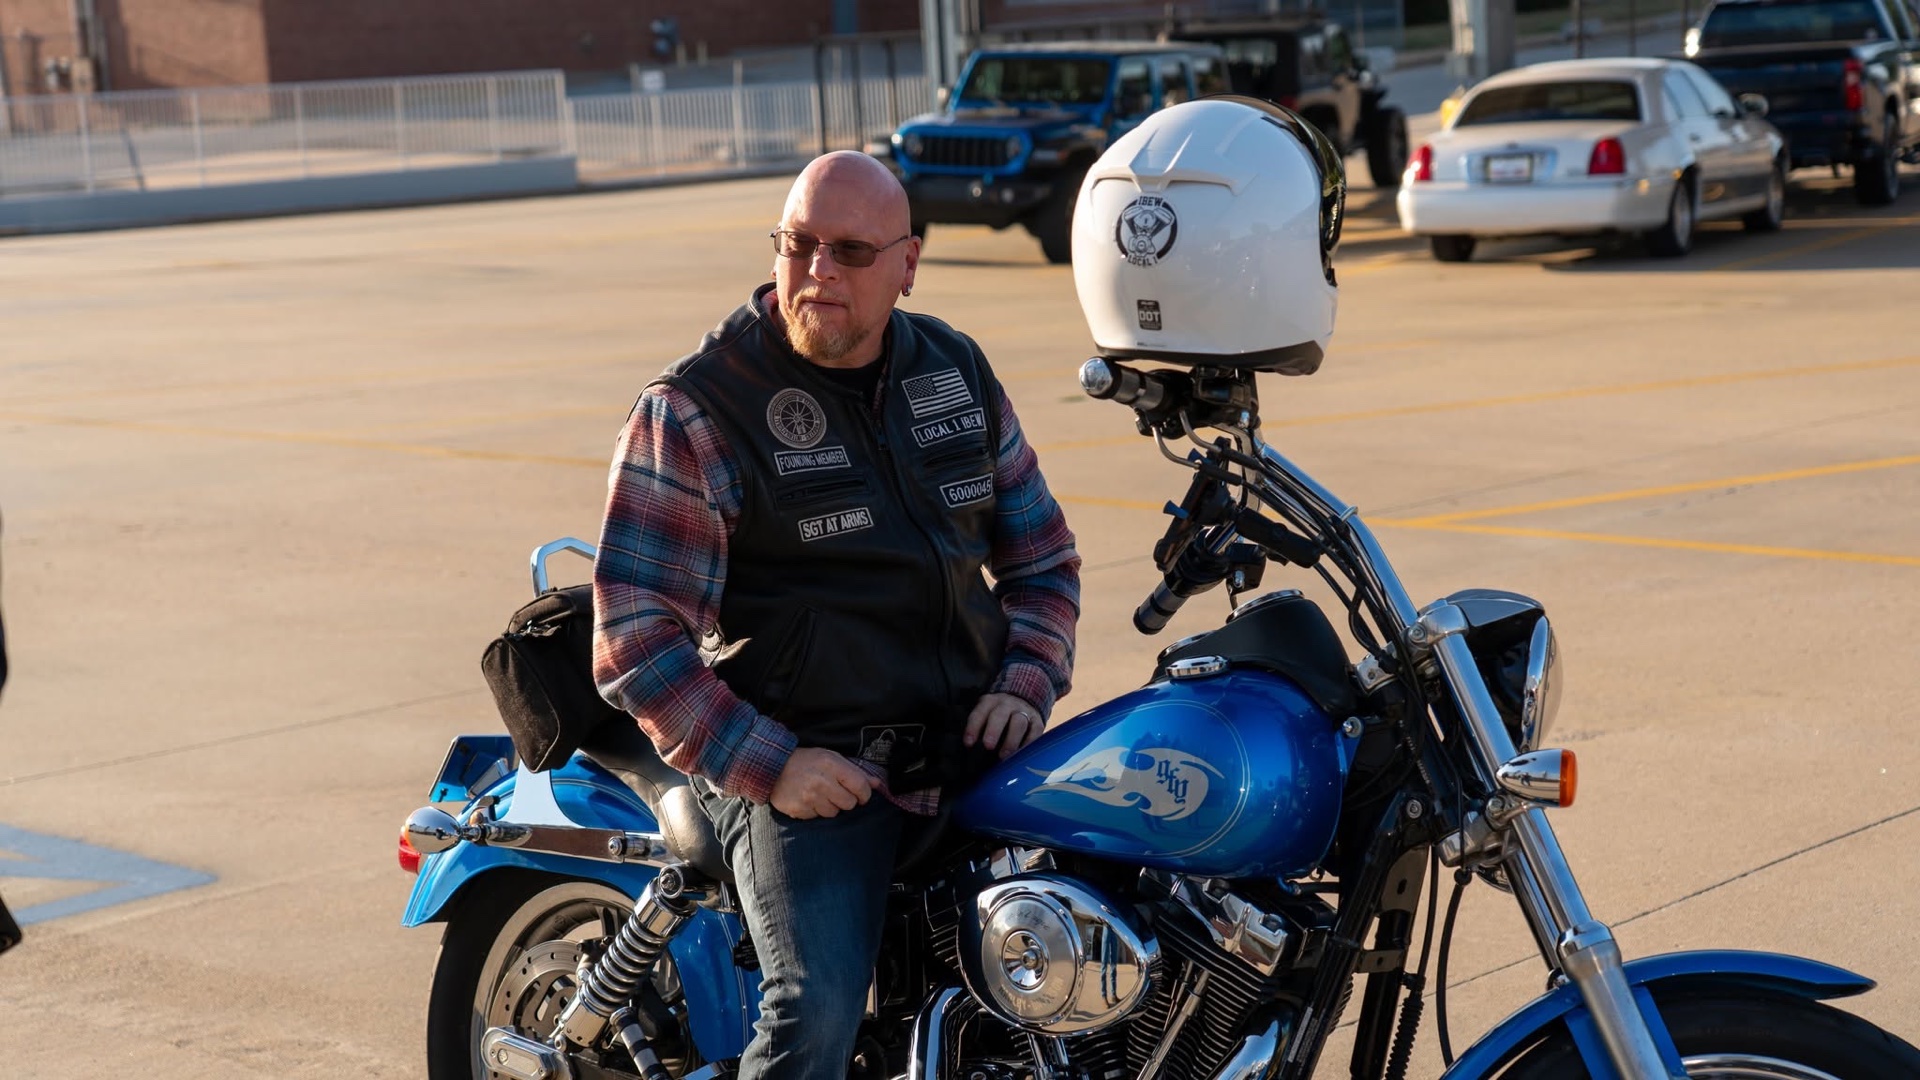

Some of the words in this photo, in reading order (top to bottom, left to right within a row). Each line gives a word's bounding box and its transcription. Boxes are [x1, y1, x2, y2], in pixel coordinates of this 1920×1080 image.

[1139, 196, 1163, 207] IBEW
[1128, 255, 1152, 267] LOCAL
[1139, 310, 1160, 322] DOT
[918, 423, 953, 442] LOCAL
[953, 420, 961, 431] 1
[961, 413, 983, 429] IBEW
[779, 454, 816, 471] FOUNDING
[816, 451, 846, 466] MEMBER
[950, 480, 991, 501] 6000045
[803, 520, 824, 538] SGT
[827, 517, 838, 533] AT
[840, 511, 869, 529] ARMS
